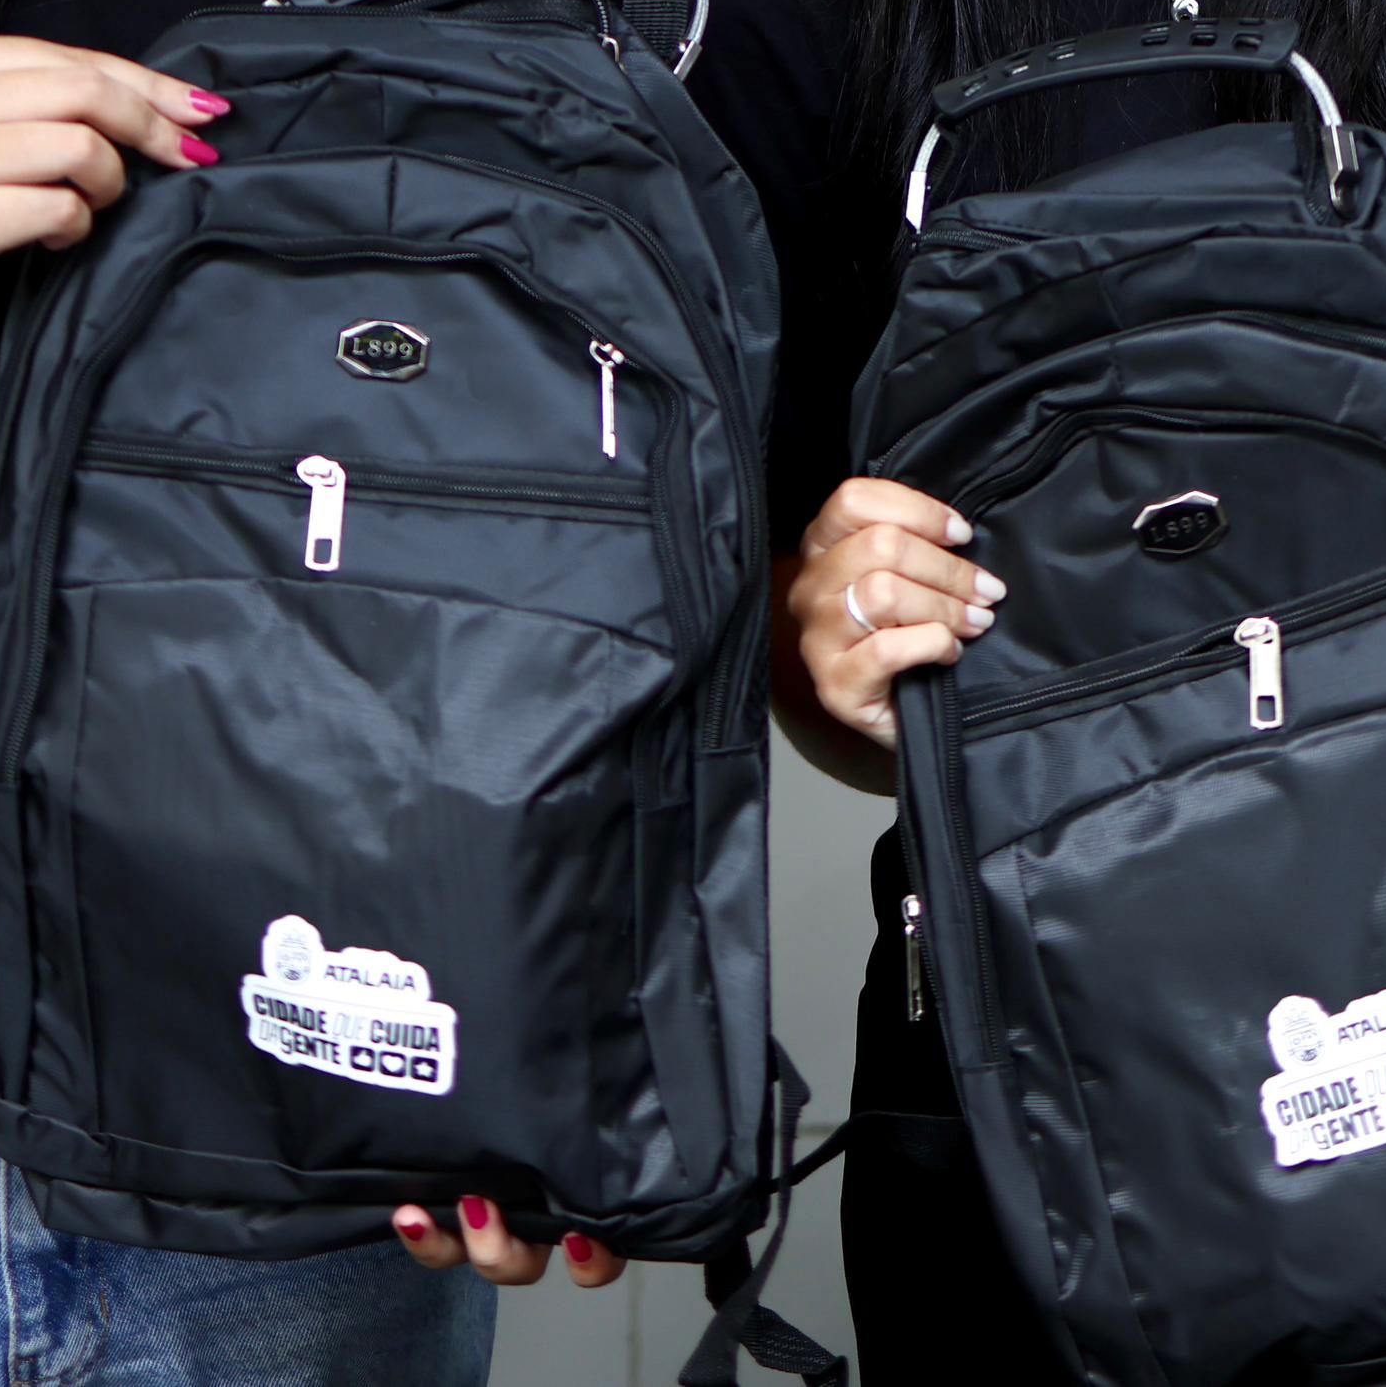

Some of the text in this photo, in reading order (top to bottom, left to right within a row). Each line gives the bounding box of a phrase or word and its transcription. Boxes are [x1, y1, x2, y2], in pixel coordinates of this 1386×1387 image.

[324, 964, 416, 991] ATALAIA
[253, 993, 328, 1034] CIDADE
[370, 1019, 442, 1052] CUIDA
[280, 1027, 342, 1065] GENTE
[1276, 1076, 1362, 1126] CIDADE
[1311, 1105, 1386, 1150] GENTE
